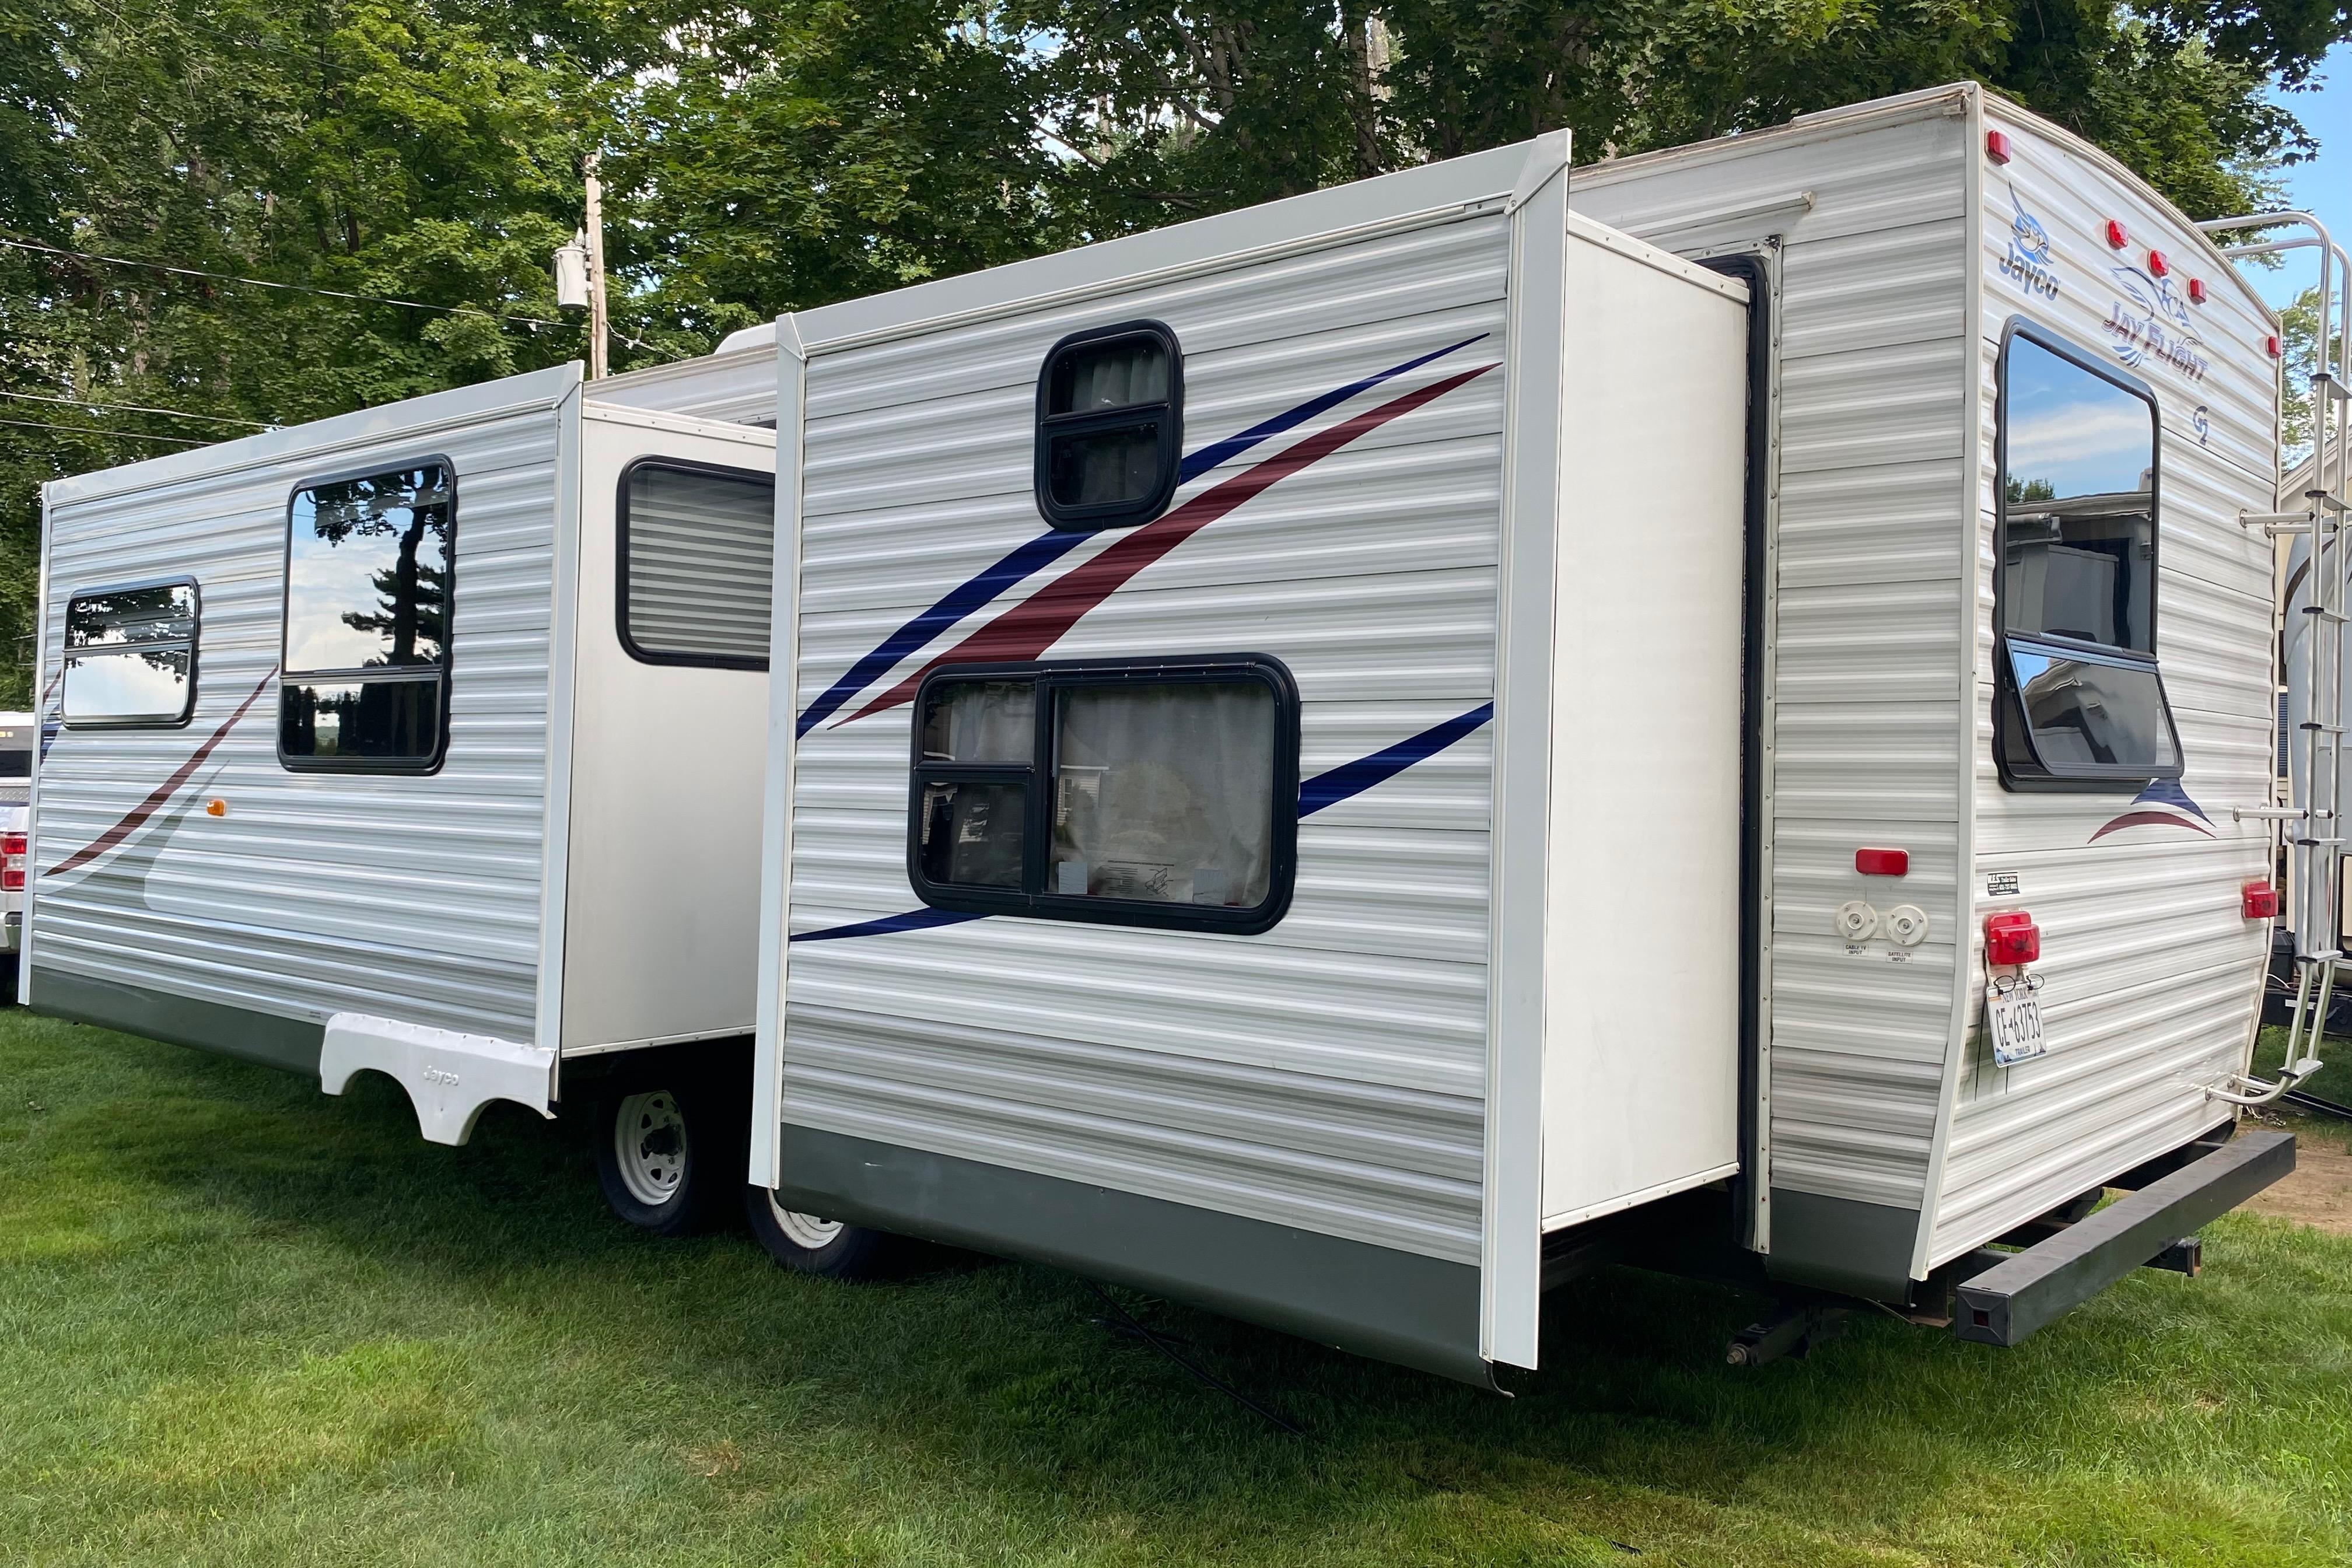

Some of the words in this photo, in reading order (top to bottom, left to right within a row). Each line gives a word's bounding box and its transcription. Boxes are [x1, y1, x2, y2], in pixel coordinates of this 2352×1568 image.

[1999, 242, 2059, 301] Jayco
[2101, 301, 2144, 346] JAY
[2142, 323, 2208, 383] FLIGHT
[2193, 405, 2208, 446] G2
[2002, 991, 2014, 1003] NEW
[2014, 986, 2028, 1002] YORK
[2015, 1046, 2031, 1056] TRAILER
[424, 1065, 459, 1086] Jayco
